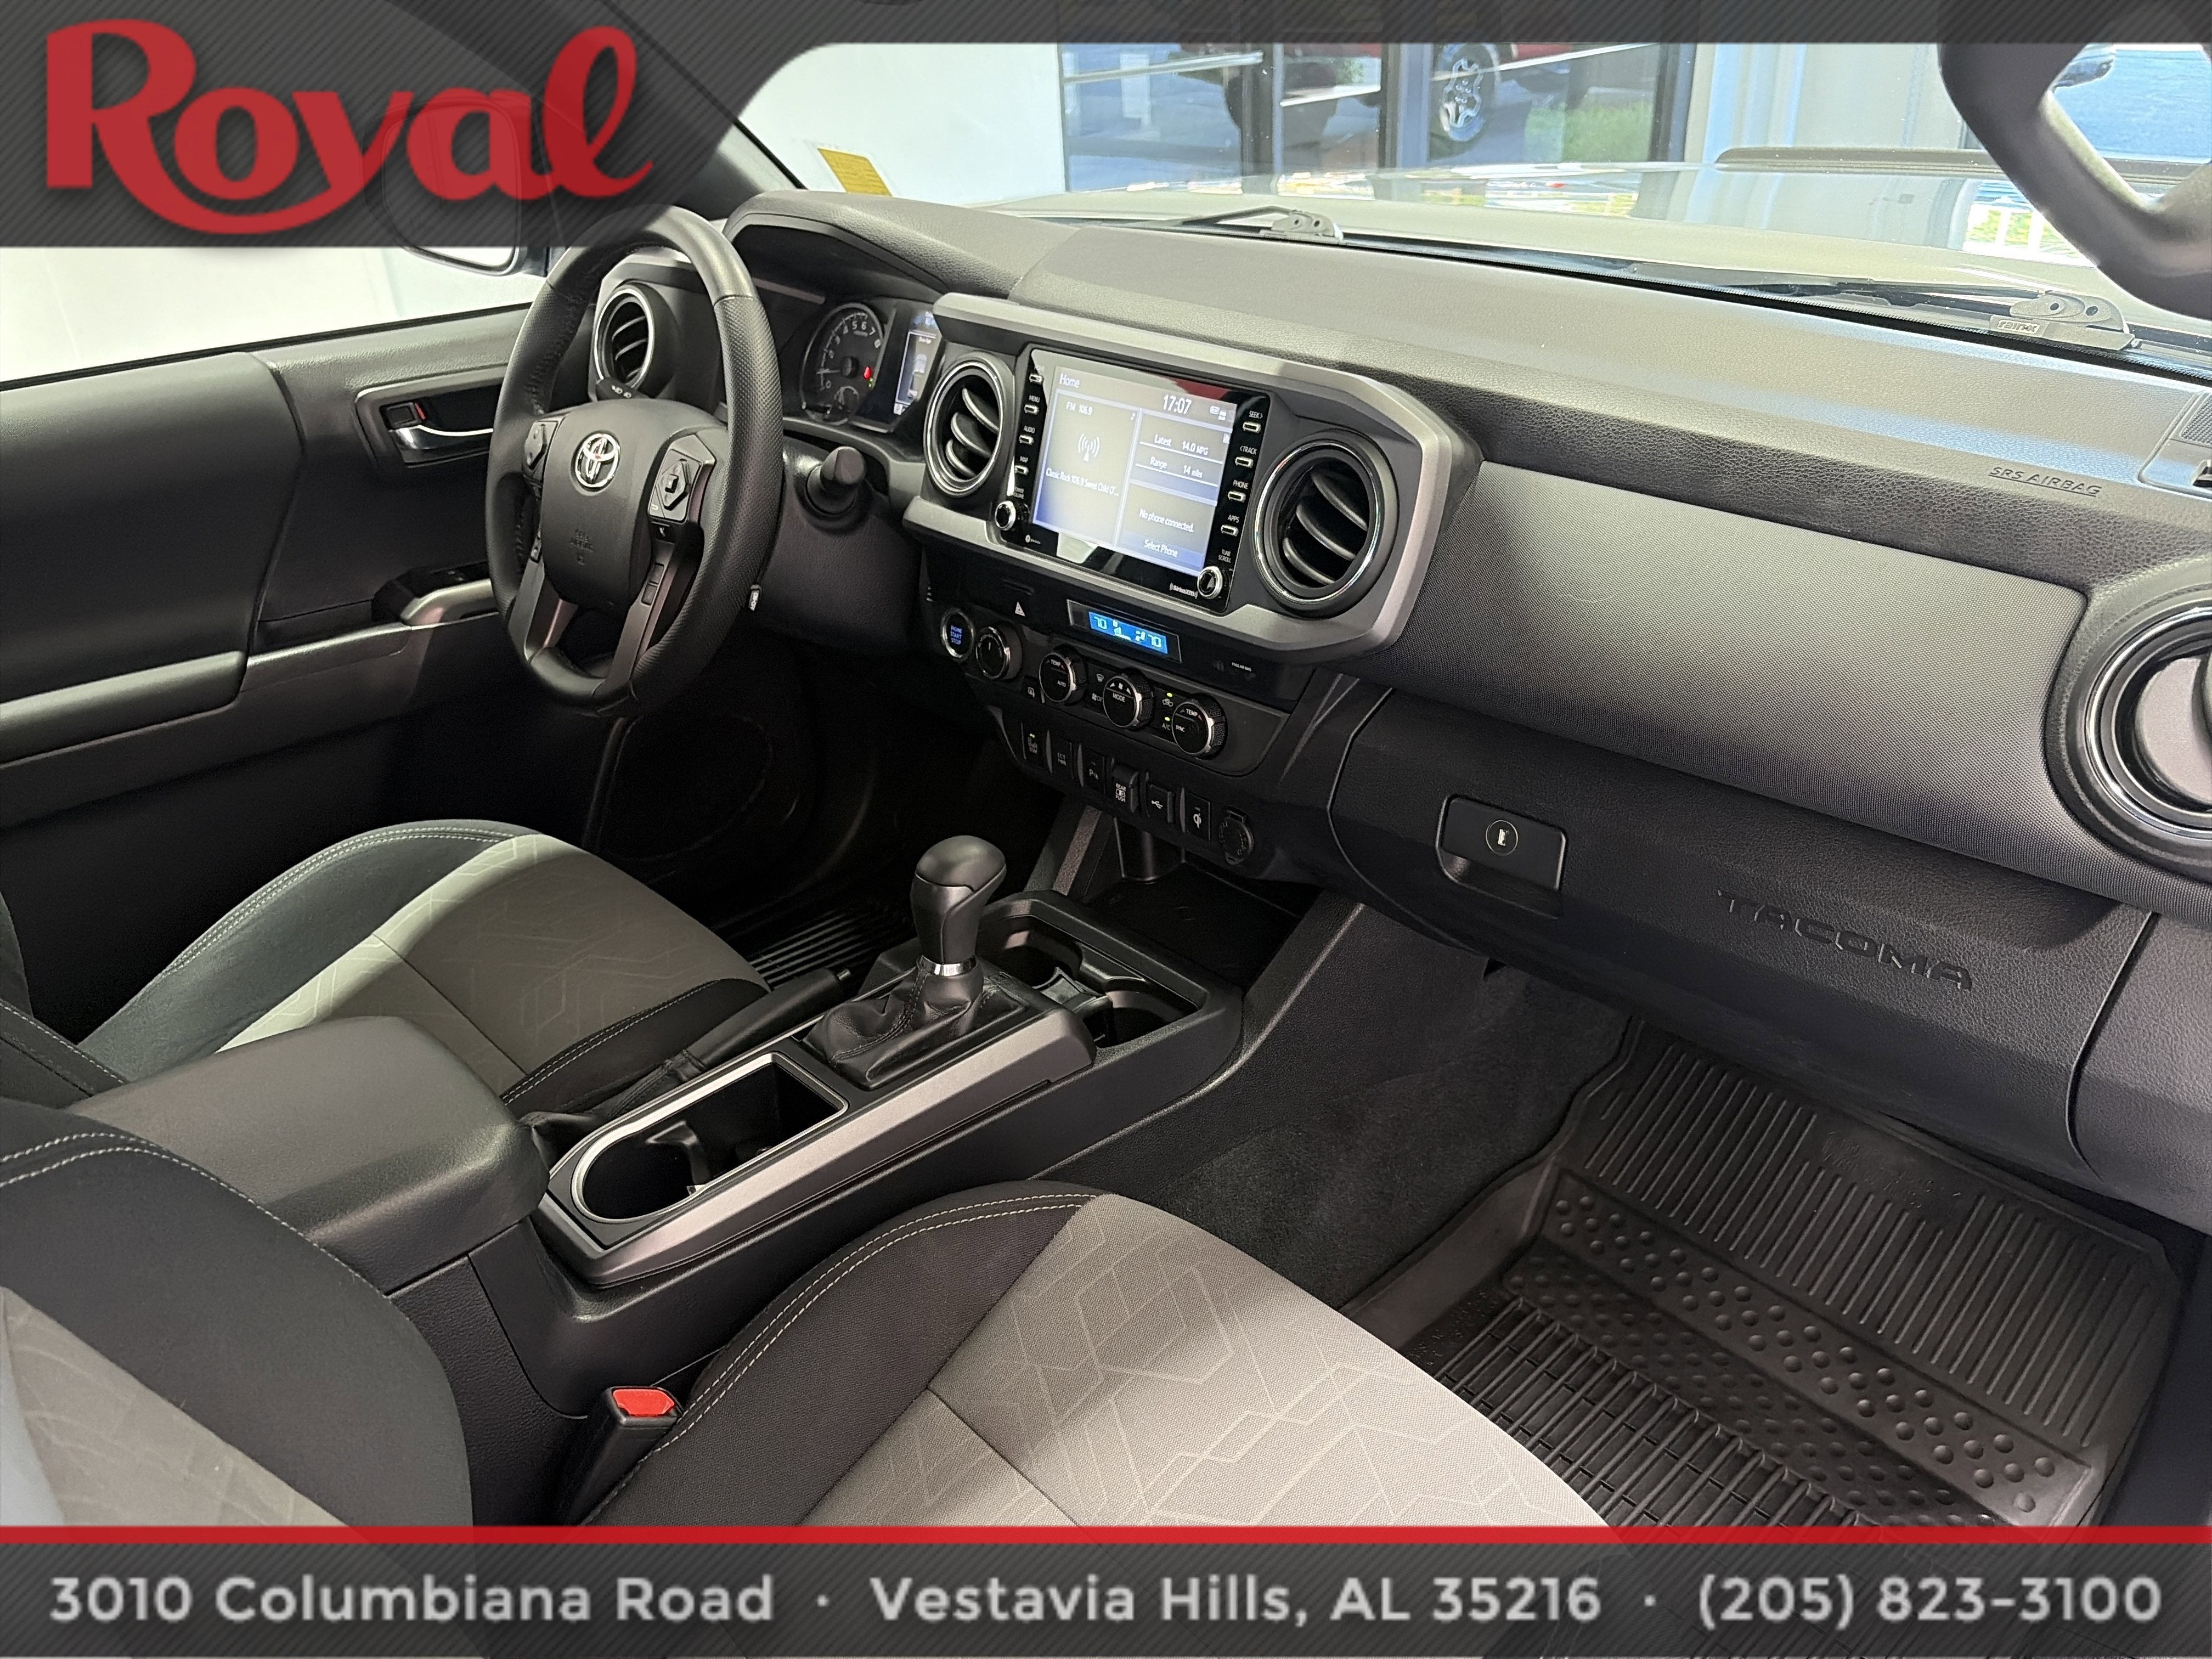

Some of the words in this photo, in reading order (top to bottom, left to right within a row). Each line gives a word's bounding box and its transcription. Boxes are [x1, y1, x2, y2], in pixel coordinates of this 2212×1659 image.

[852, 321, 857, 330] 5
[861, 321, 867, 330] 6
[1059, 373, 1080, 388] Home
[1066, 402, 1076, 411] FM
[1163, 394, 1192, 414] 17:07
[1154, 434, 1172, 447] Latest
[1182, 441, 1195, 452] 14.0
[1150, 456, 1167, 469] Range
[1183, 465, 1190, 475] 14
[1233, 479, 1249, 489] PHONE
[1989, 467, 2023, 480] SRS
[2027, 473, 2102, 495] AIRBAG
[1139, 509, 1148, 519] No
[1148, 512, 1165, 524] phone
[1165, 517, 1194, 533] connected.
[1228, 515, 1240, 523] APPS
[1144, 539, 1160, 551] Select
[1160, 544, 1178, 557] Phone
[1093, 616, 1108, 630] 70
[1148, 634, 1162, 648] 70
[1112, 692, 1125, 703] MODE
[1186, 708, 1198, 718] TEMP
[1162, 722, 1171, 731] A/C
[1175, 724, 1185, 732] SYNC
[1717, 889, 1972, 990] TACOMA
